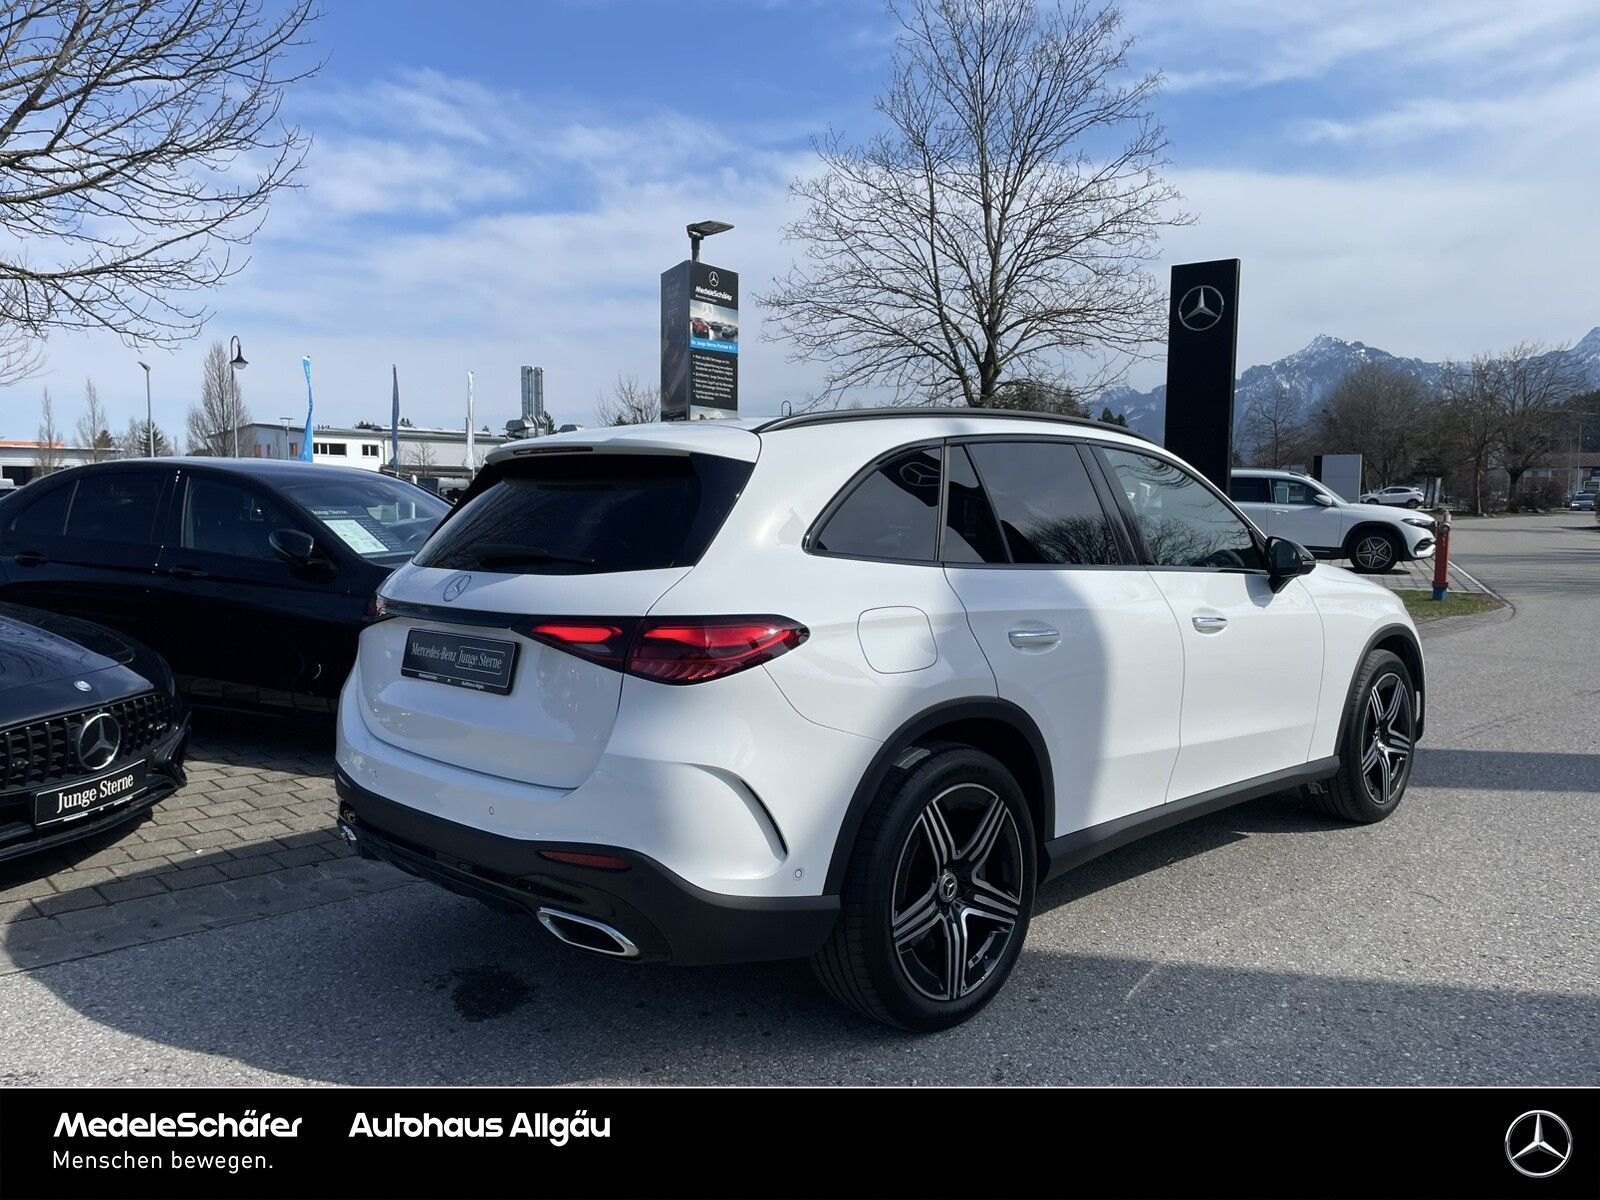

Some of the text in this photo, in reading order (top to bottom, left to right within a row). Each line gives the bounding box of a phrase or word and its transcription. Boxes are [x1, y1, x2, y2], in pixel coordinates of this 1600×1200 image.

[411, 642, 502, 669] Mercedes-Benz Junge Sterne
[56, 788, 97, 814] Junge
[99, 774, 134, 799] Sterne
